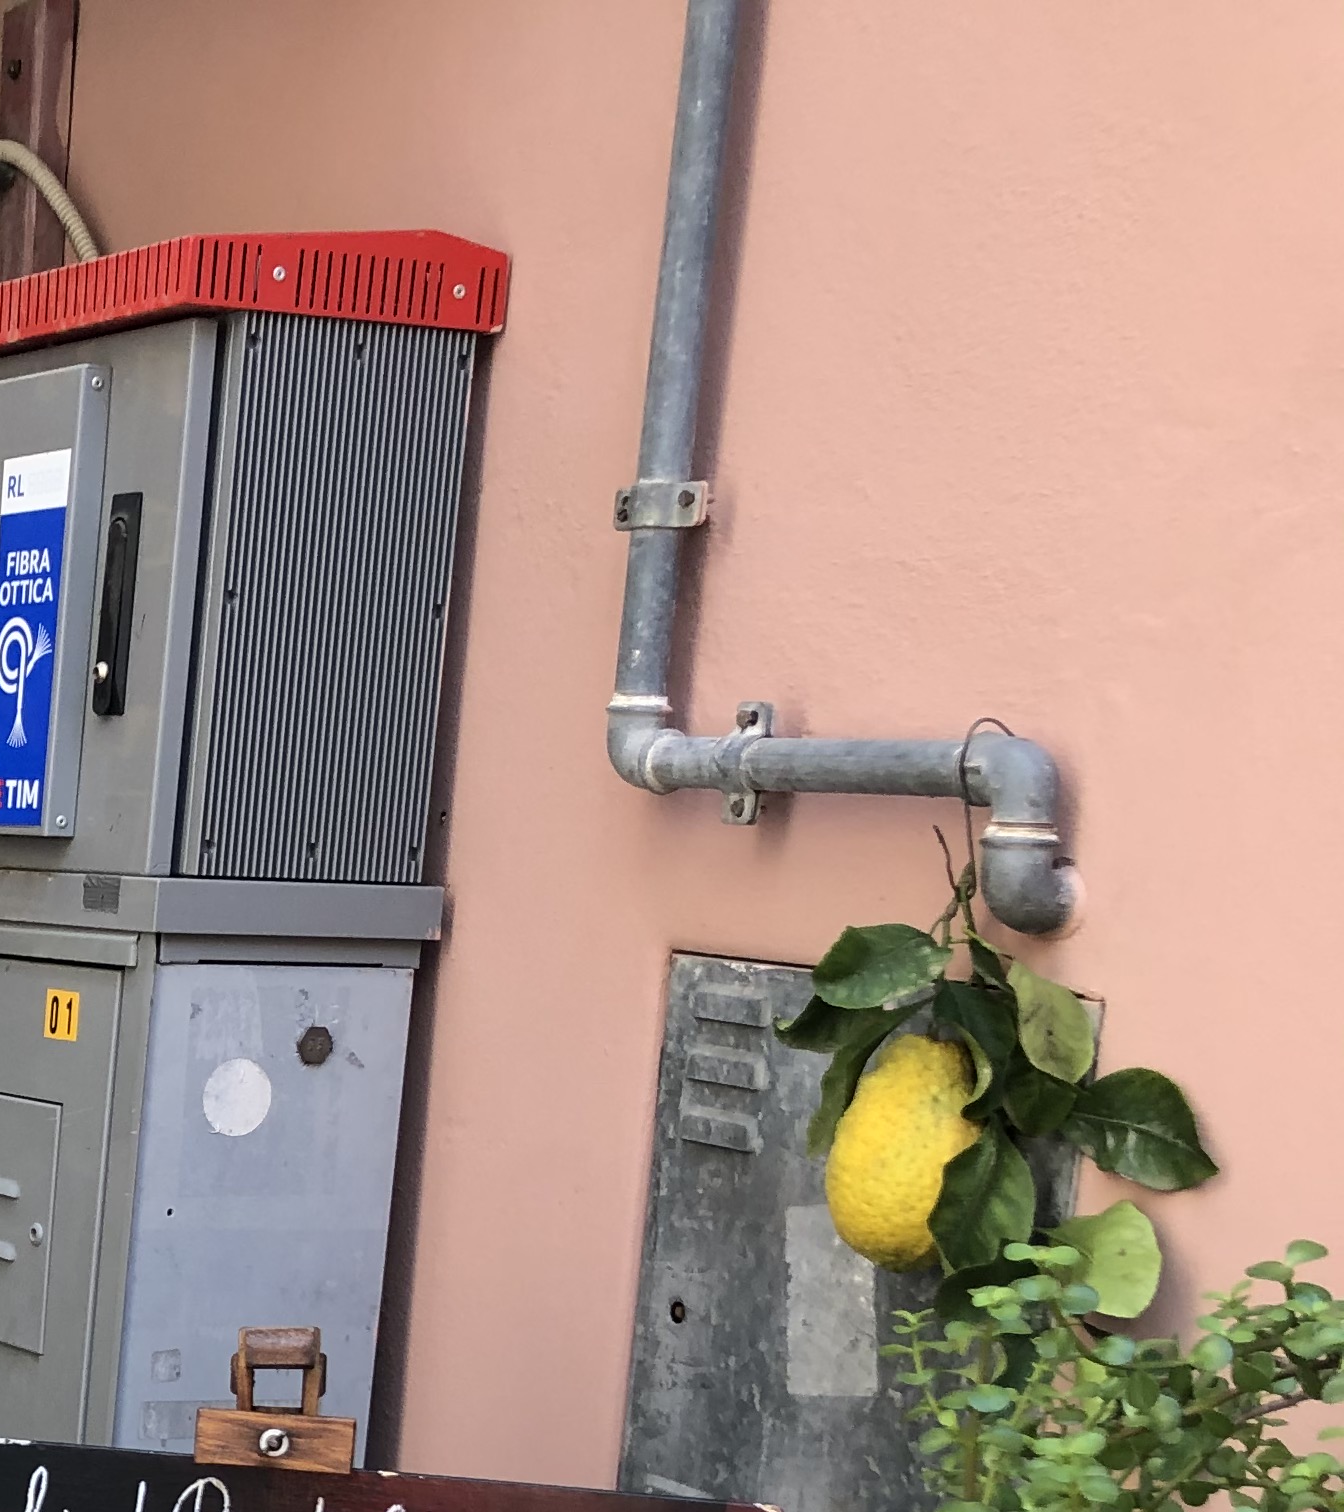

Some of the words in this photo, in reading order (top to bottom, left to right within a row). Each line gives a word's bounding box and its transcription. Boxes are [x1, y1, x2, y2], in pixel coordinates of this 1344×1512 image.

[6, 474, 25, 499] RL
[6, 547, 51, 577] FIBRA
[0, 576, 55, 607] OTTICA
[5, 778, 40, 810] TIM
